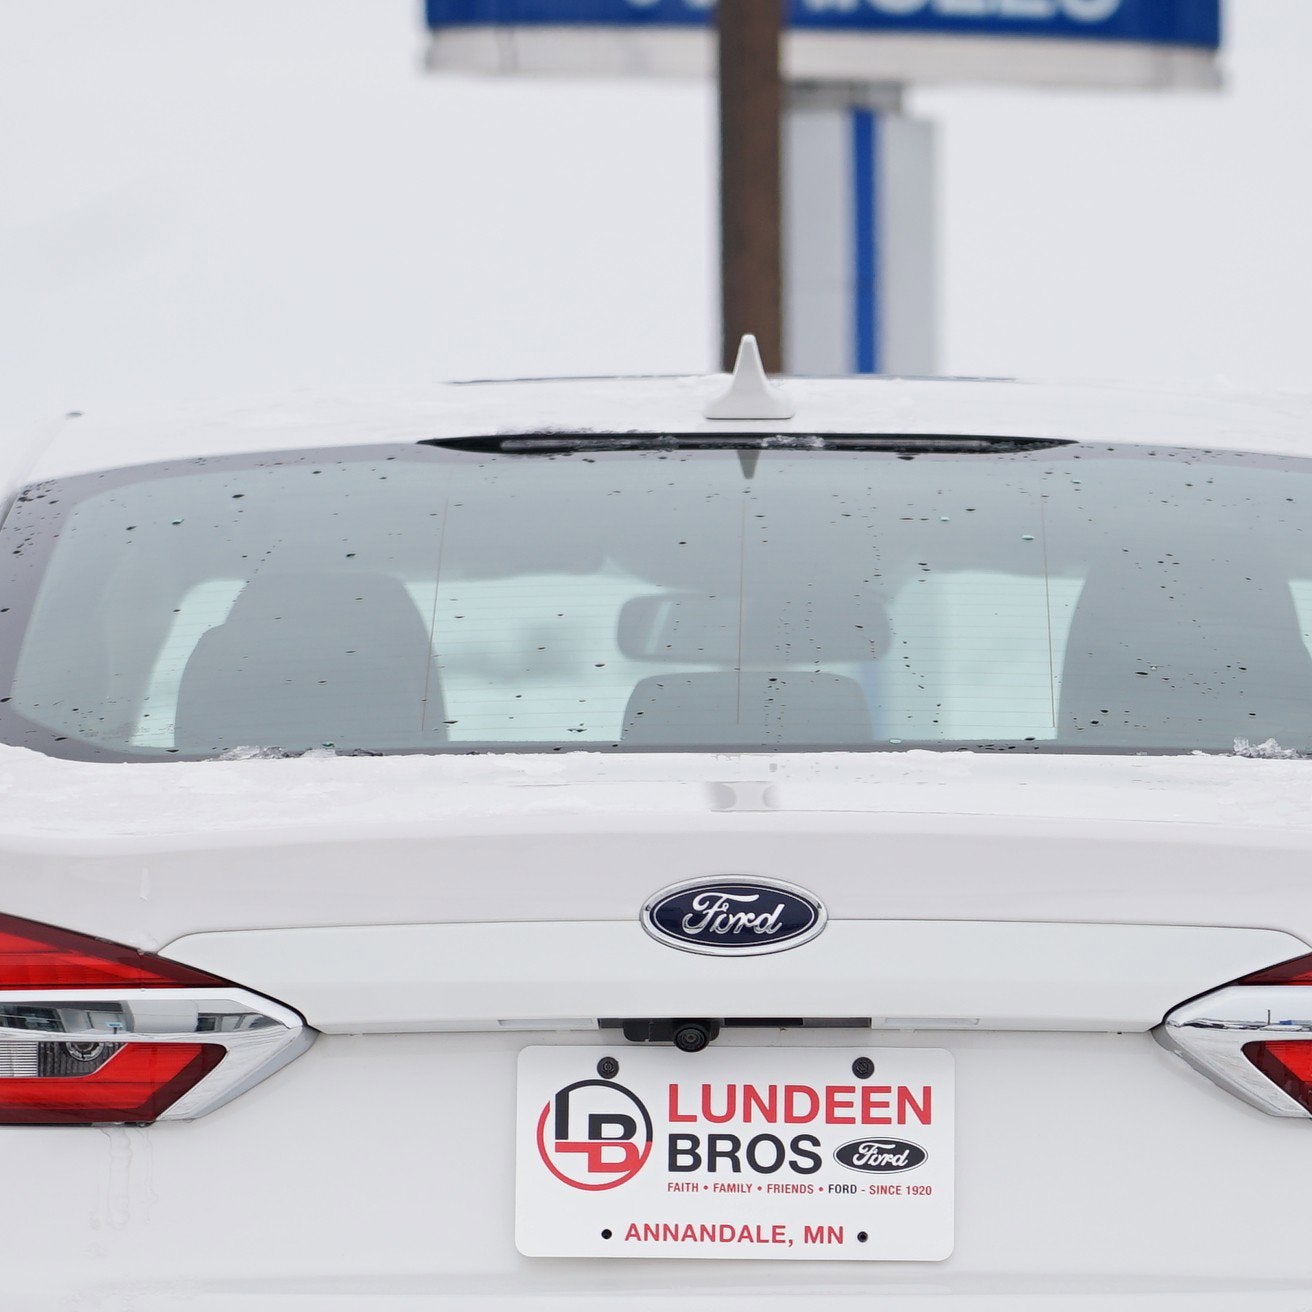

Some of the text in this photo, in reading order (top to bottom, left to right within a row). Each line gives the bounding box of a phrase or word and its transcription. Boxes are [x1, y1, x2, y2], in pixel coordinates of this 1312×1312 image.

[682, 892, 785, 935] Ford
[668, 1083, 932, 1126] LUNDEEN
[667, 1133, 823, 1176] BROS
[852, 1141, 910, 1167] Ford
[667, 1182, 932, 1197] FAITH FAMILY FRIENDS FORD SINCE 1920
[624, 1223, 844, 1248] ANNANDALE, MN
